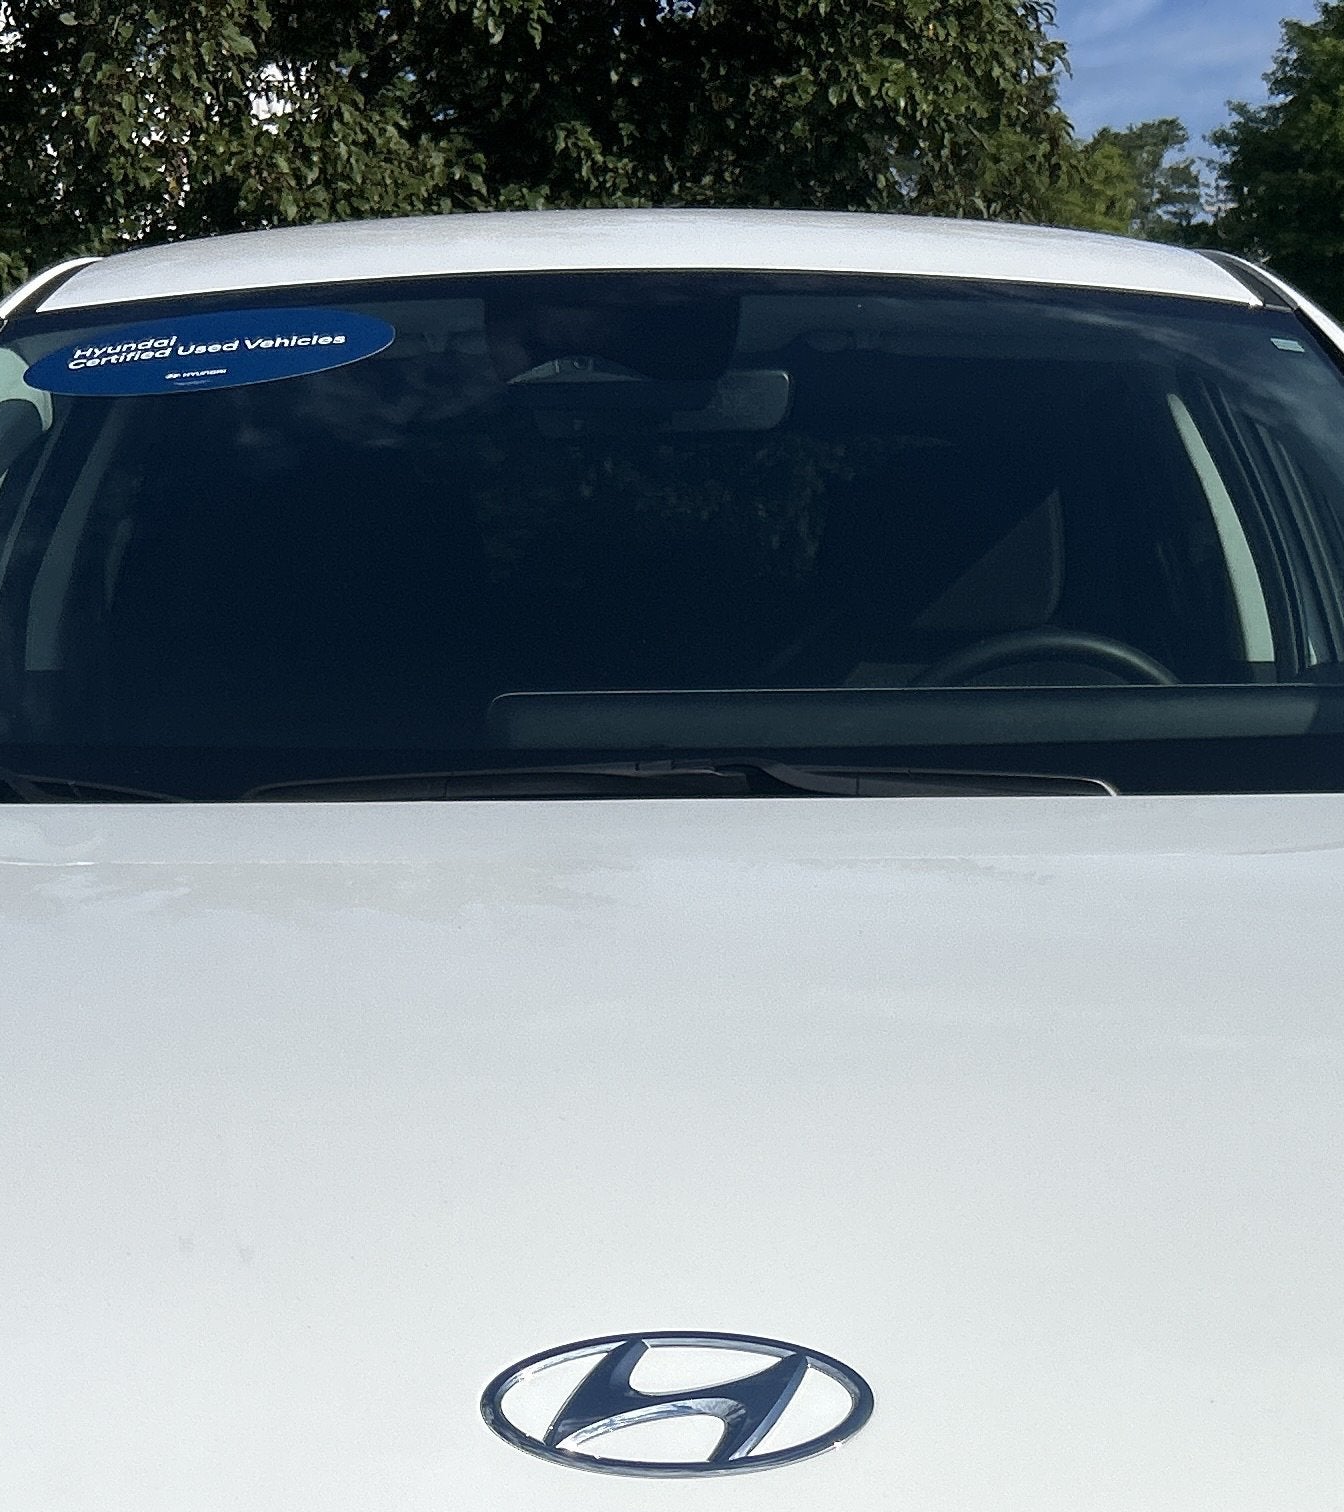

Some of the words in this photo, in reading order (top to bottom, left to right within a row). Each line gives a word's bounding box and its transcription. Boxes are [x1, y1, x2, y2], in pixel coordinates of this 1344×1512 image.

[68, 348, 172, 369] Certified
[177, 339, 239, 356] Used
[244, 334, 346, 350] Vehicles
[74, 336, 177, 358] Hyundai
[182, 369, 227, 378] HYUNDAI
